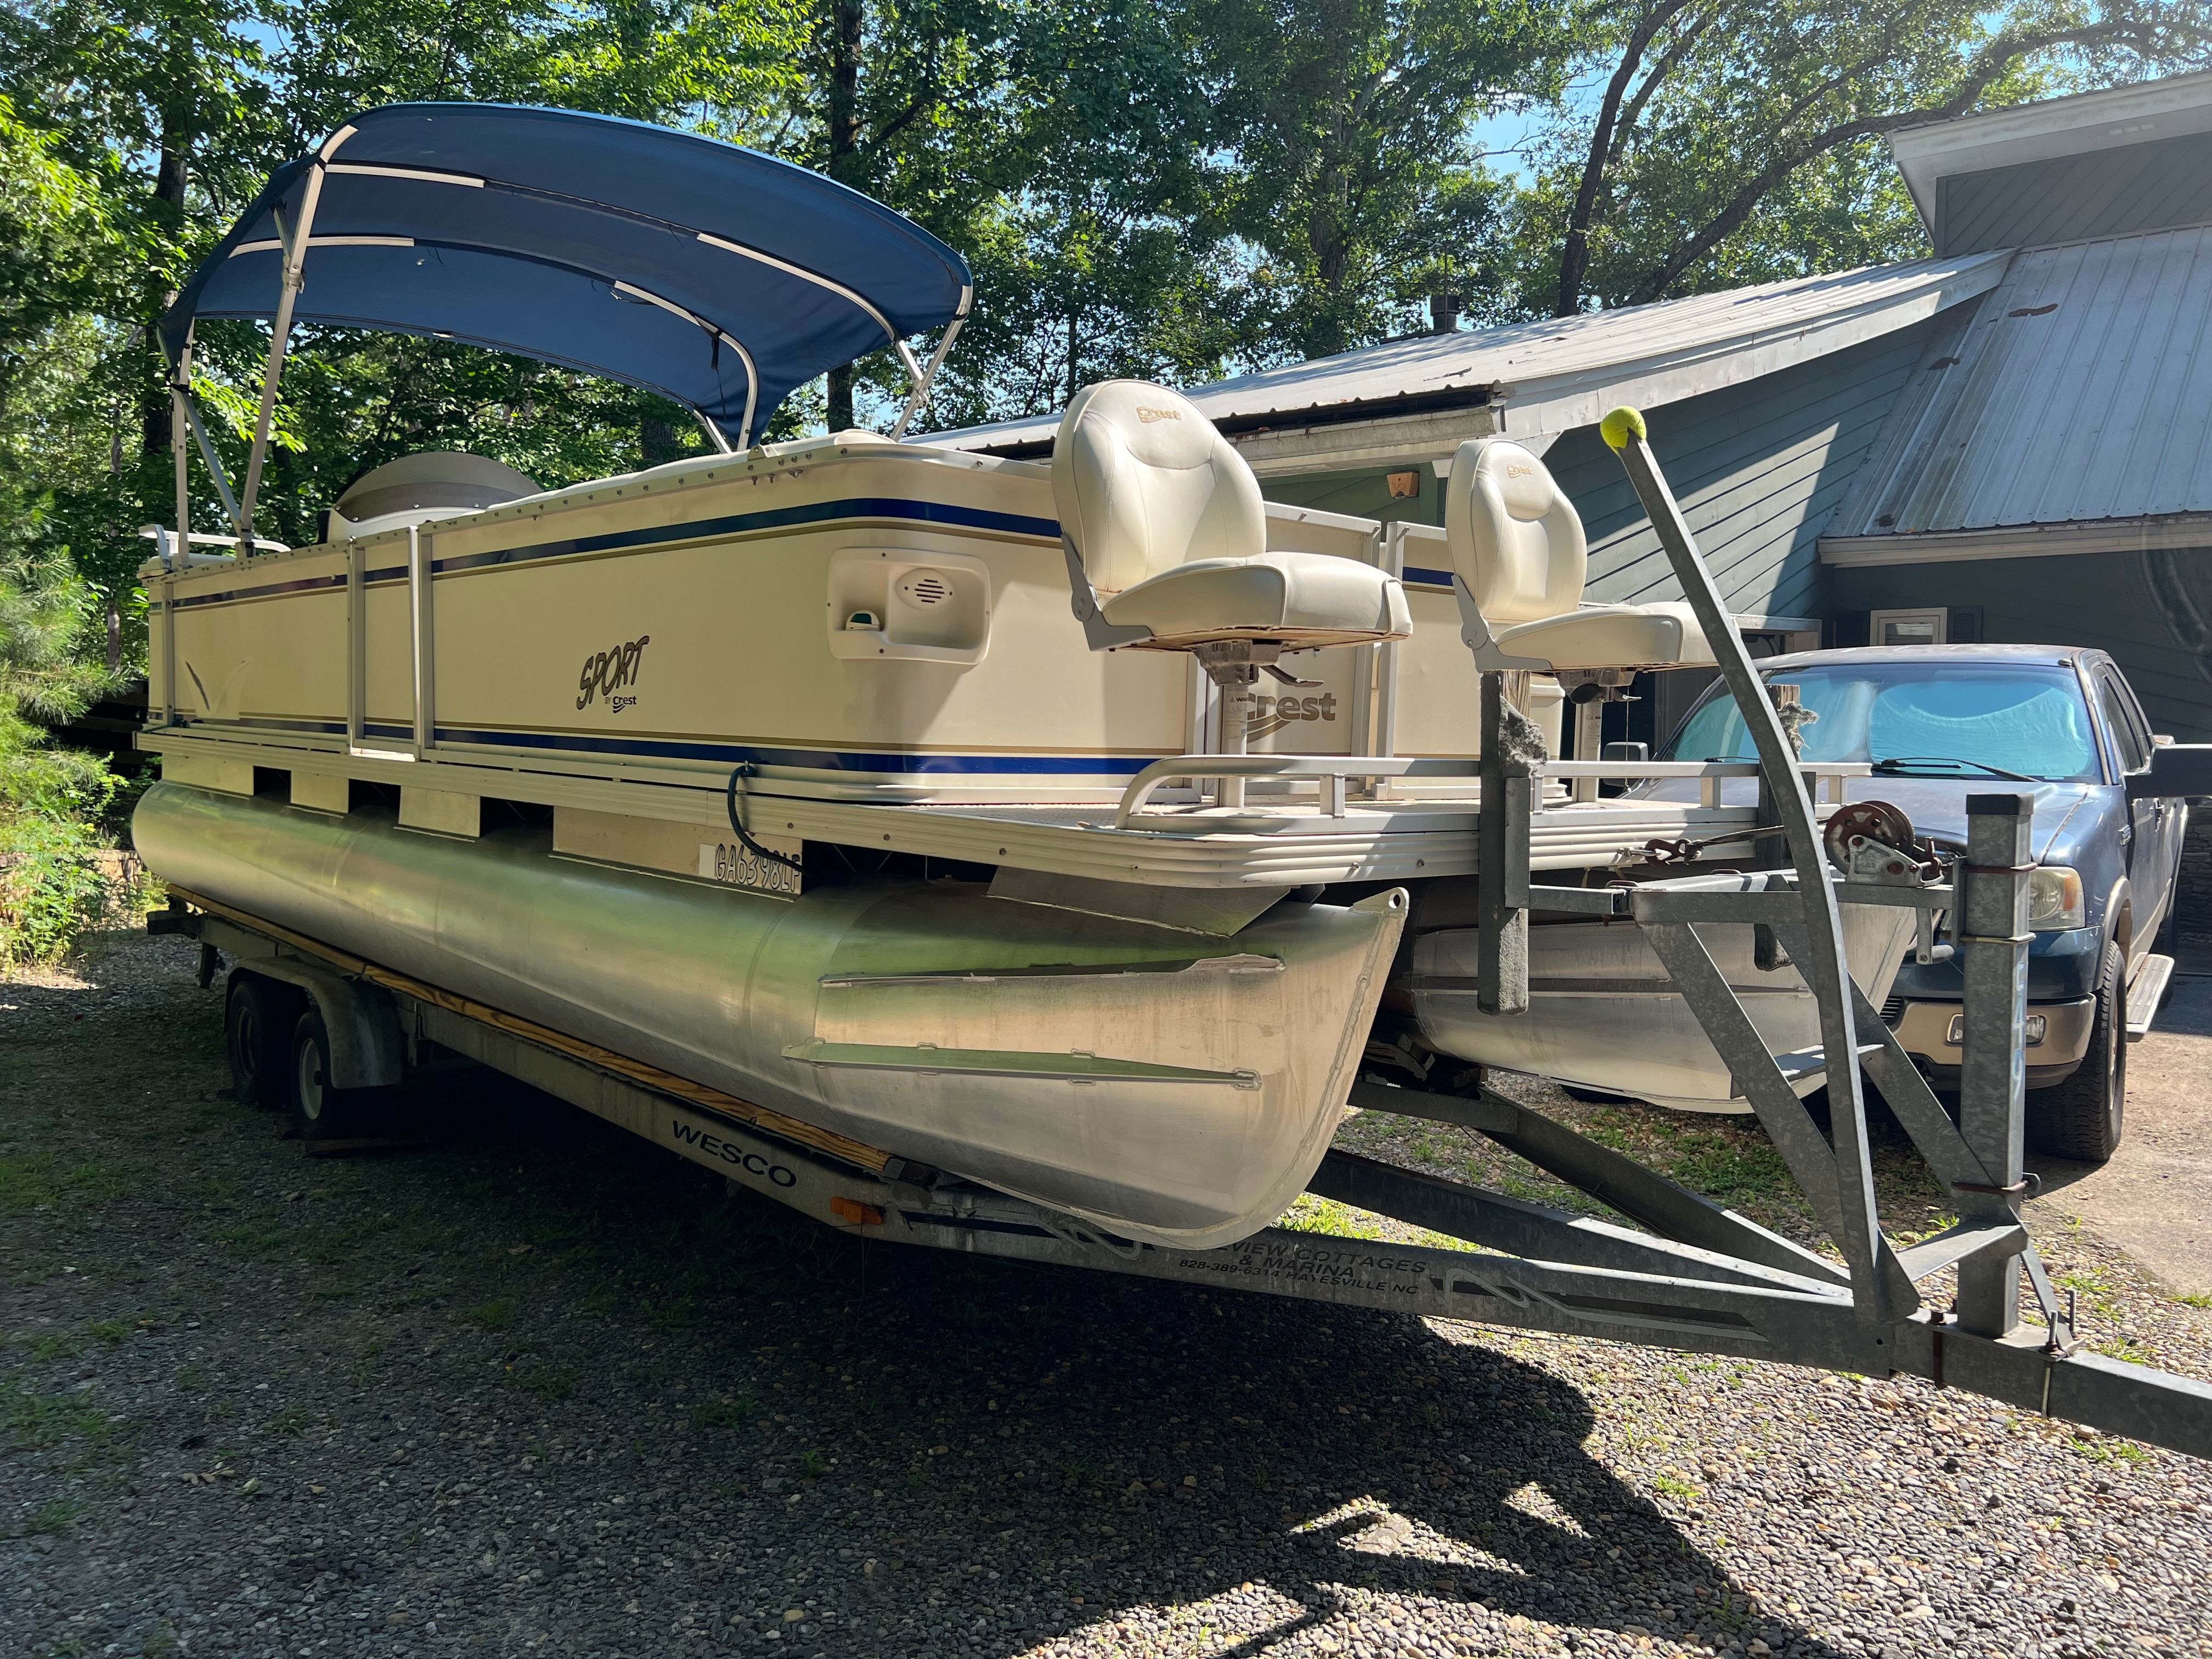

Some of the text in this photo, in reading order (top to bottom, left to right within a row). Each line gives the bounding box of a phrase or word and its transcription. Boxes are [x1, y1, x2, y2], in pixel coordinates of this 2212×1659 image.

[577, 635, 650, 710] SPORT
[673, 1120, 797, 1187] WESCO
[1216, 1242, 1427, 1273] VIEW COTTAGES
[1239, 1255, 1354, 1277] & MARINA
[1180, 1259, 1419, 1294] 828-389-6314 HAYESVILLE NC
